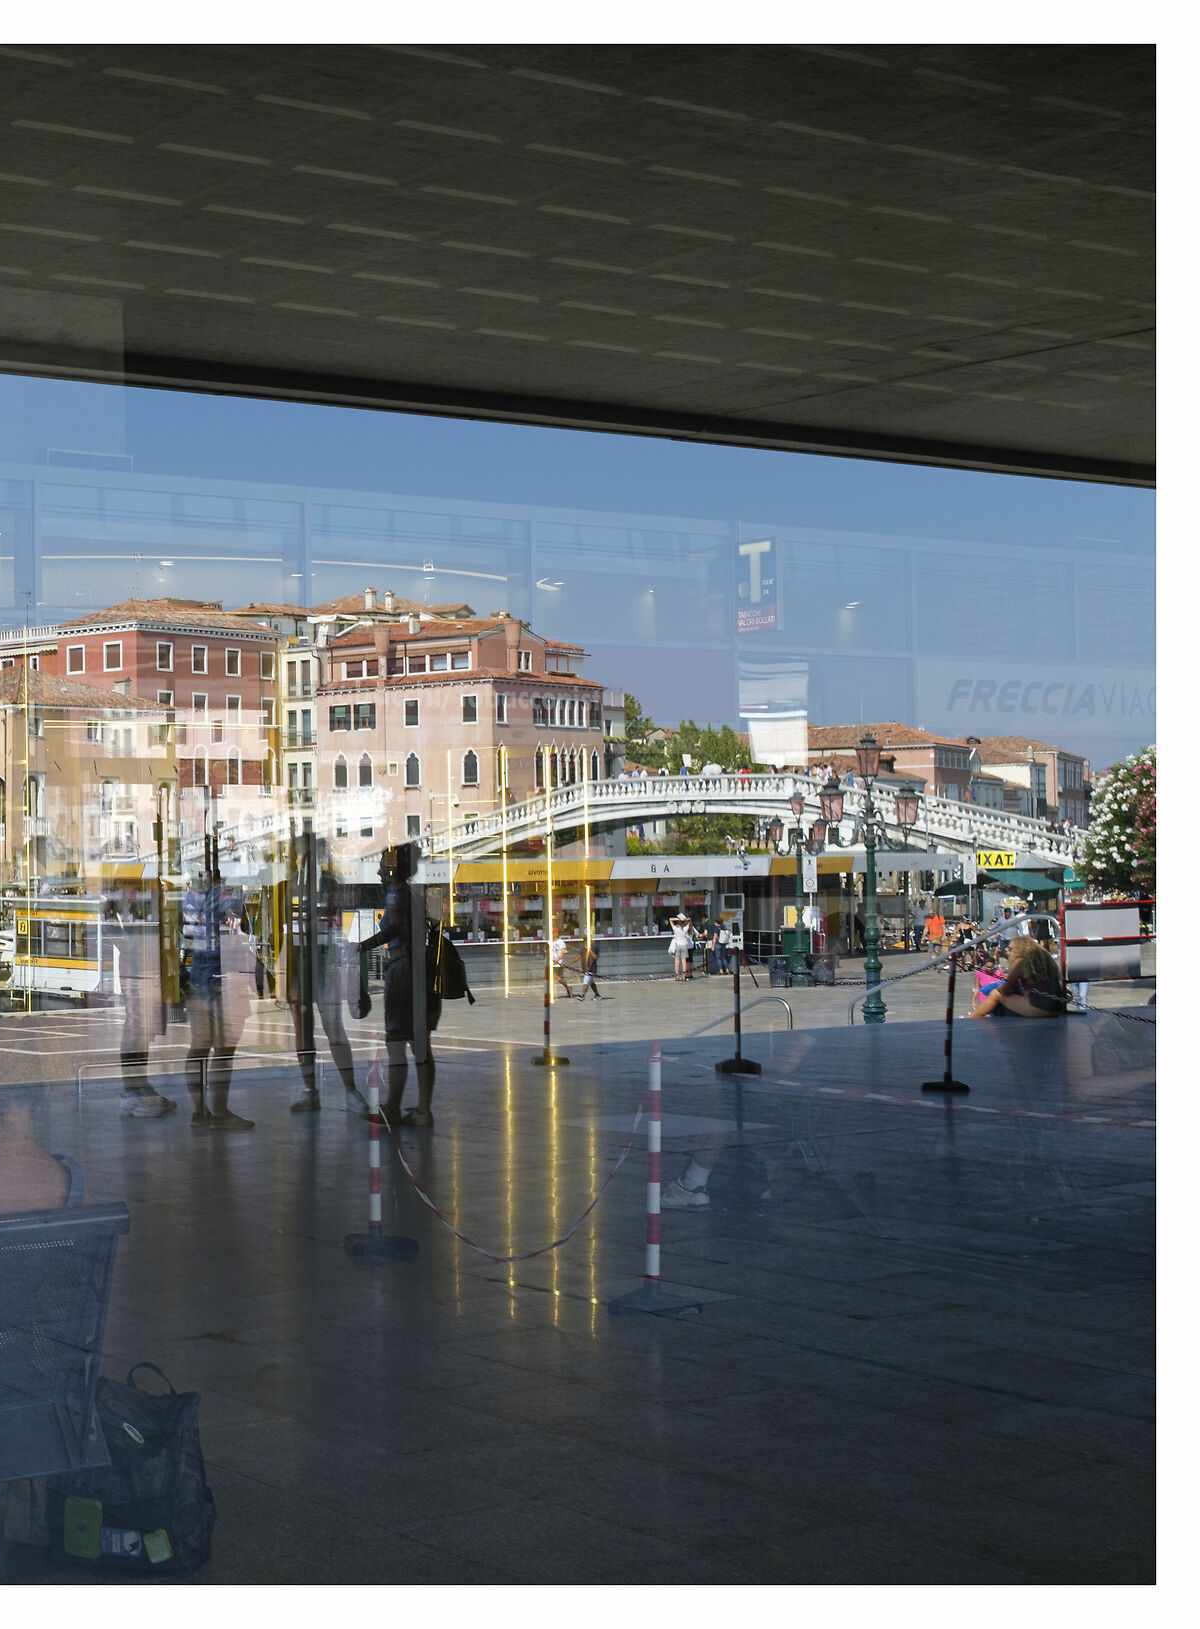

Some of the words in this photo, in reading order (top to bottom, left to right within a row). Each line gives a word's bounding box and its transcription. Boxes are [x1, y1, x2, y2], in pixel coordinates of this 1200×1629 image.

[739, 540, 771, 603] T
[738, 609, 761, 619] TABACCHI
[738, 618, 755, 626] VALORI
[755, 615, 775, 625] BOLLATI
